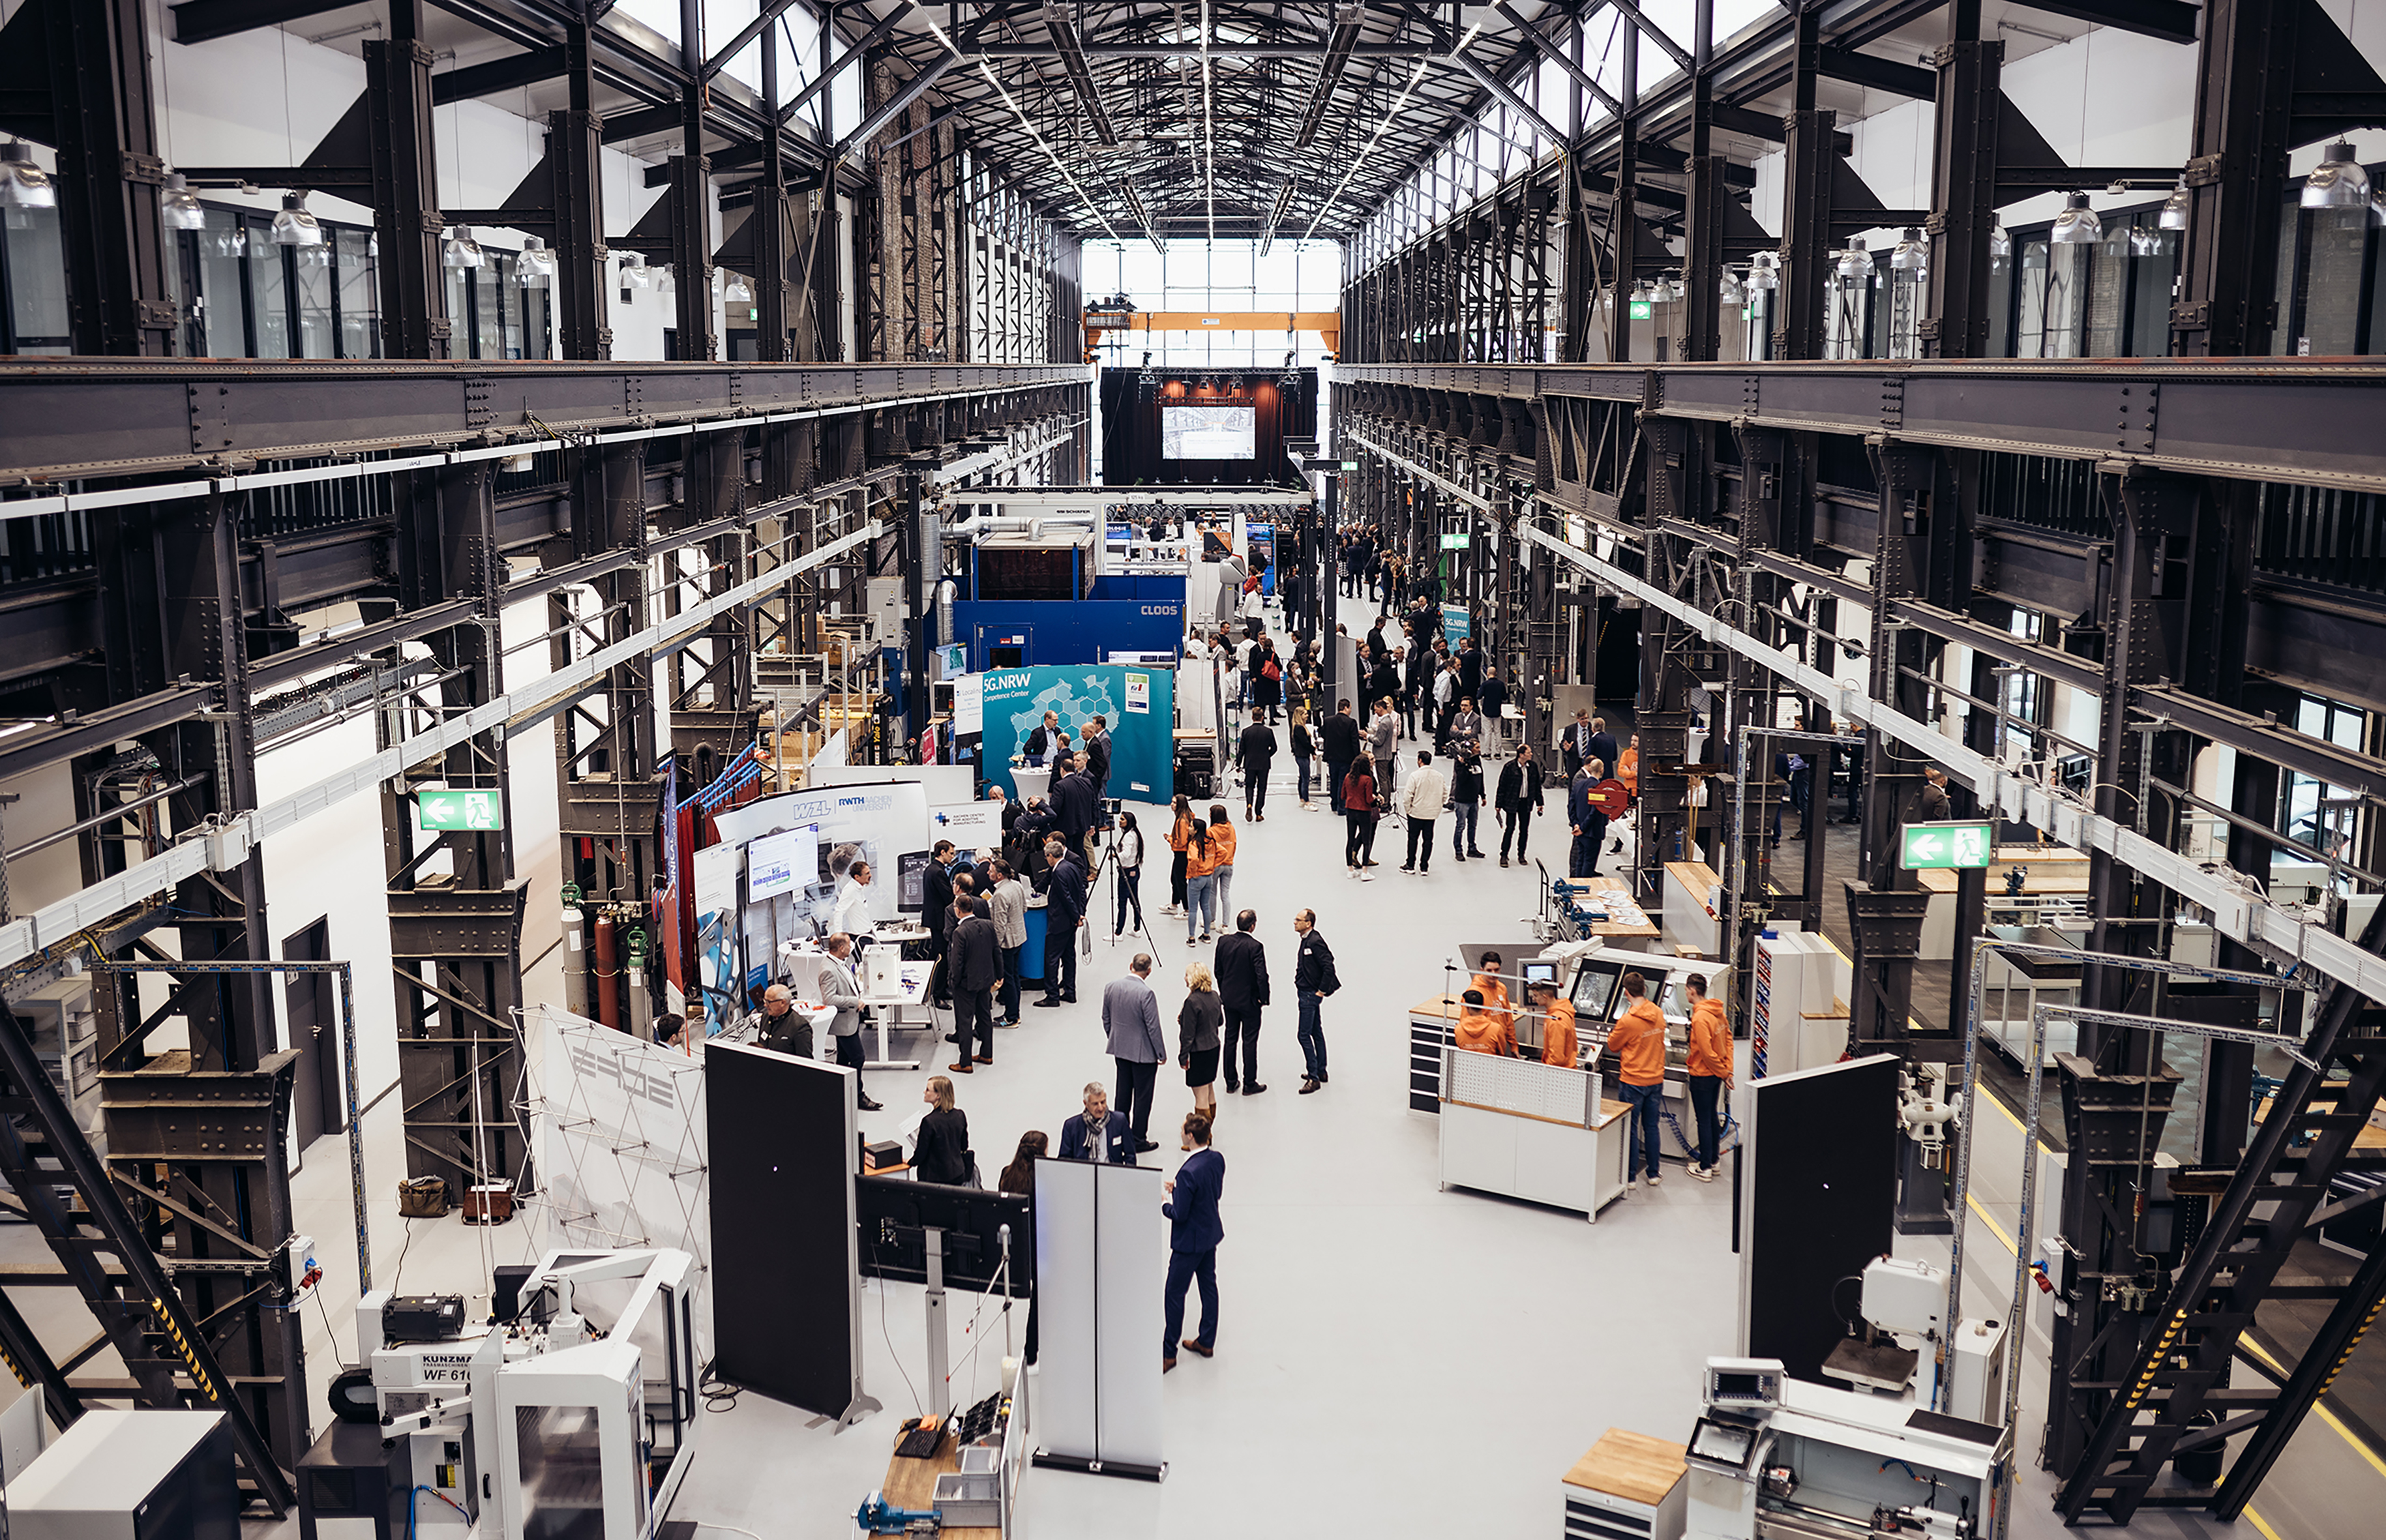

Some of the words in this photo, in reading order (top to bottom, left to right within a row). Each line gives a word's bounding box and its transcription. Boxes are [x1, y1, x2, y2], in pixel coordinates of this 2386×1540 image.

[1141, 606, 1178, 615] CLOOS
[983, 673, 1031, 692] 5G.NRW
[983, 692, 1010, 702] Competence
[839, 797, 865, 806] RWTH
[793, 800, 831, 820] WZL
[852, 803, 892, 812] UNIVERSITY
[424, 1370, 447, 1381] WF
